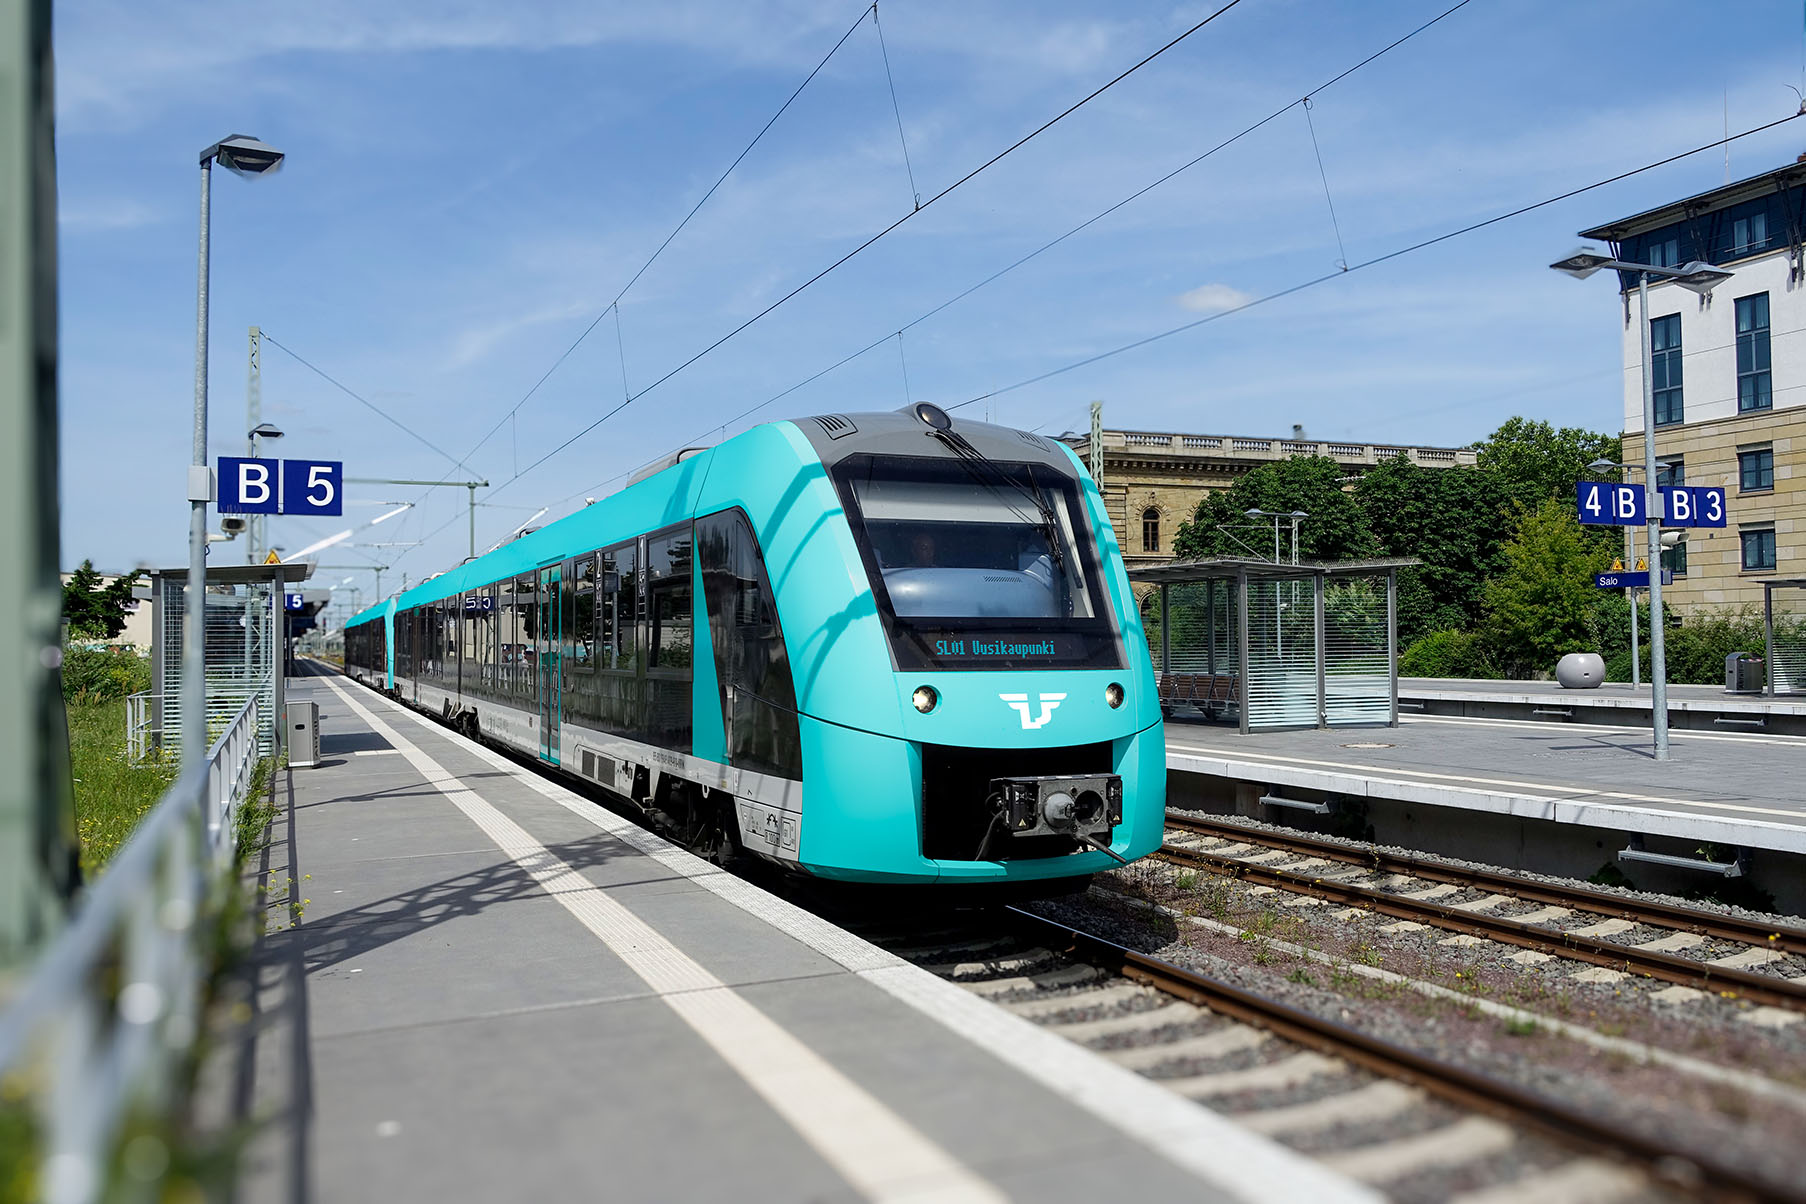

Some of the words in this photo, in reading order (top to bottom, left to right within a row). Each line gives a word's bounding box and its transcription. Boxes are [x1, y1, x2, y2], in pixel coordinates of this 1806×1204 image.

[238, 463, 271, 504] B
[306, 466, 335, 507] 5
[1585, 485, 1601, 517] 4
[1618, 487, 1636, 519] B
[1673, 490, 1690, 520] B
[1706, 490, 1722, 521] 3
[1599, 576, 1618, 586] Salo
[292, 594, 302, 608] 5
[935, 640, 966, 655] SL01
[972, 640, 1056, 659] Uusikaupunki
